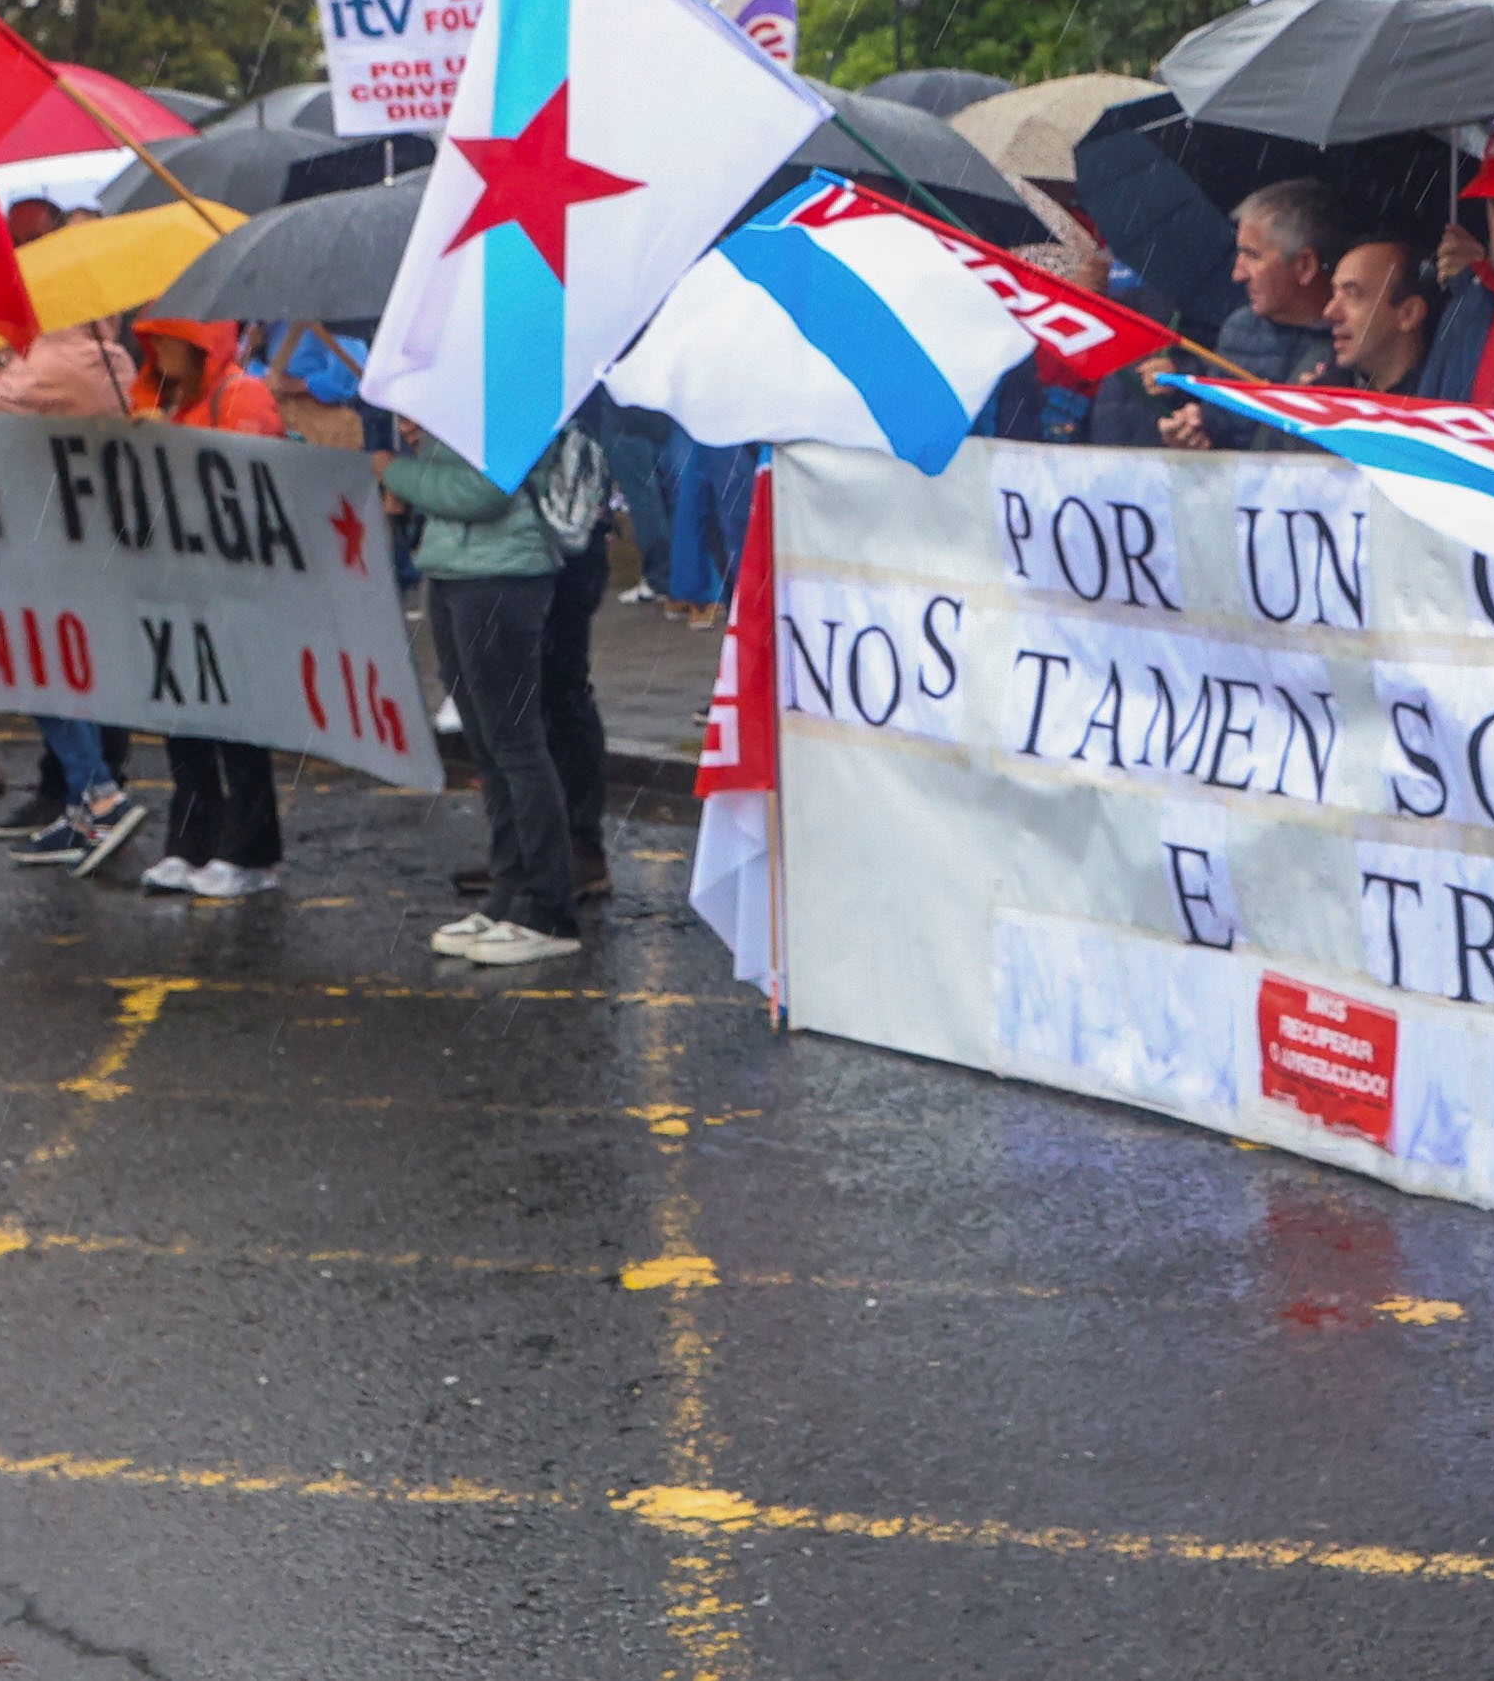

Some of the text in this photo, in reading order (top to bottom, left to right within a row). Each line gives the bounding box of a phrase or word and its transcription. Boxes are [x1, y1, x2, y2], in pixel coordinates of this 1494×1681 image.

[370, 61, 433, 79] POR
[424, 5, 482, 34] FOL
[49, 436, 307, 572] FOLGA
[1000, 488, 1183, 613] POR
[1236, 506, 1366, 630] UN
[780, 596, 965, 727] NOS
[1014, 649, 1335, 803] TAMEN
[1162, 841, 1236, 951] E
